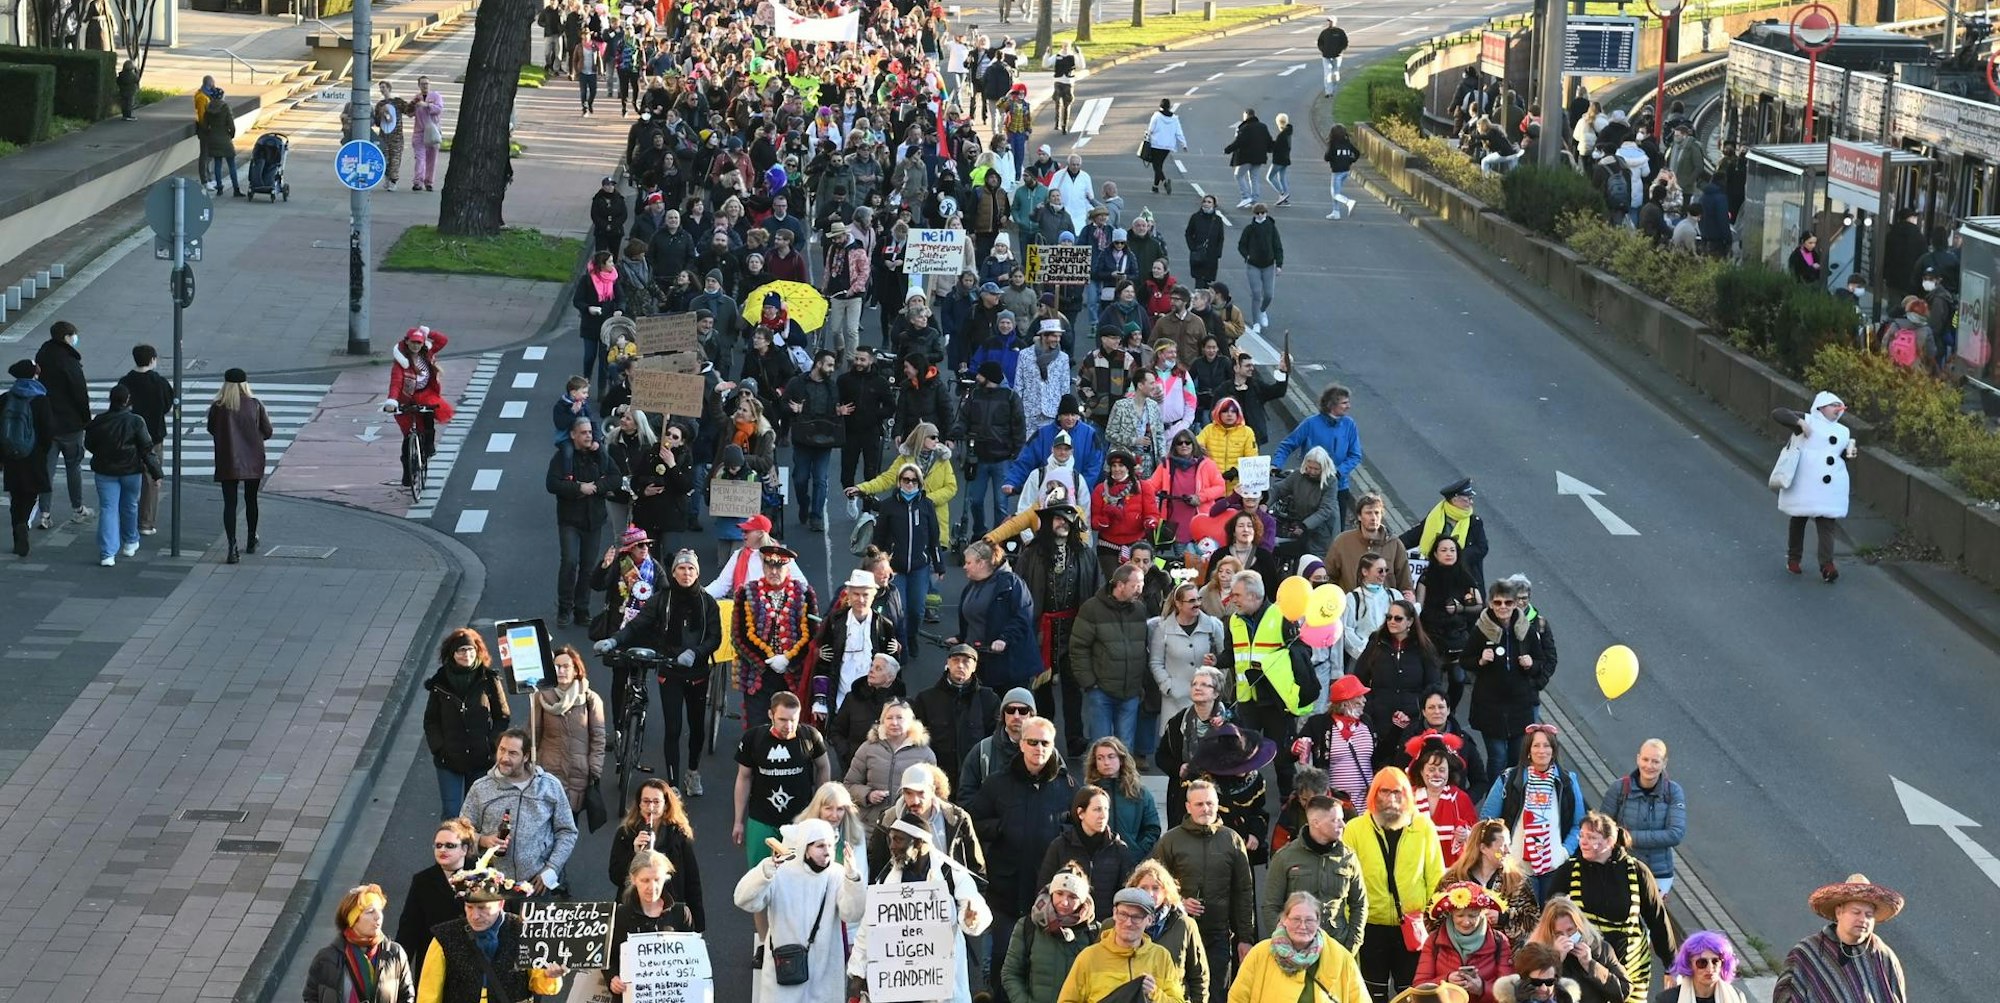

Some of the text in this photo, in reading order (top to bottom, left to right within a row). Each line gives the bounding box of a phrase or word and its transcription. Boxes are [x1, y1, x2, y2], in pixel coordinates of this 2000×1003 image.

[1832, 148, 1879, 187] Deutzer Freiheit
[1028, 246, 1038, 282] NEIN
[521, 902, 609, 922] Untersterb-
[878, 900, 949, 923] PANDEMIE
[520, 920, 609, 938] lichkeit 2020
[885, 940, 934, 957] LÜGEN
[879, 966, 943, 989] PLANDEMIE
